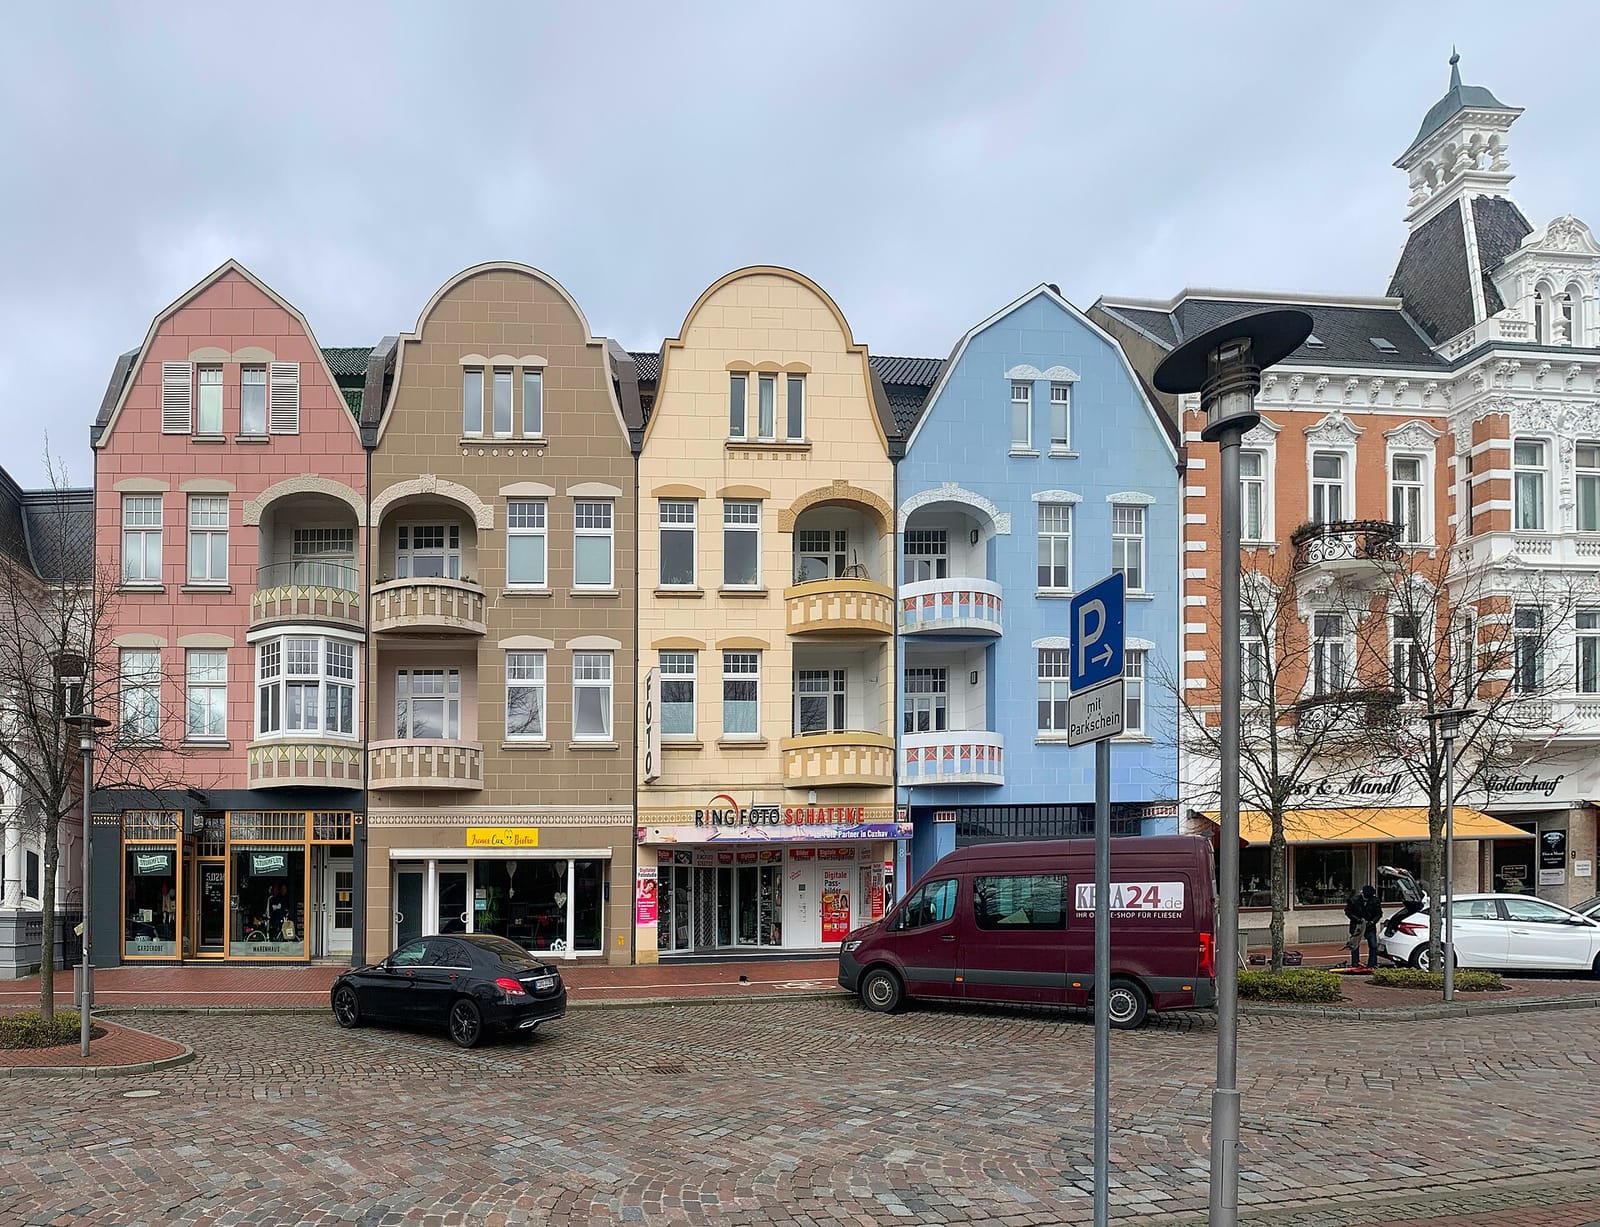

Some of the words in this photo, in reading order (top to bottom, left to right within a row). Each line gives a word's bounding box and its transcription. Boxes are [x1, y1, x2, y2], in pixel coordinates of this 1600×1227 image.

[1078, 598, 1107, 678] P
[1087, 697, 1102, 714] mit
[1070, 711, 1120, 738] Parkschein
[1317, 779, 1332, 795] &
[1339, 774, 1402, 795] Mandl
[1488, 773, 1565, 797] Goldankauf
[784, 807, 865, 826] SCHATTKE
[514, 834, 534, 845] Bistro
[838, 830, 859, 839] Partner
[860, 830, 866, 838] in
[899, 848, 905, 858] 8
[1570, 850, 1577, 860] 9
[824, 871, 848, 880] Digitale
[824, 879, 840, 887] Pass-
[824, 886, 842, 894] bilder
[1077, 885, 1182, 909] KEA24.de
[1138, 911, 1152, 919] FÜR
